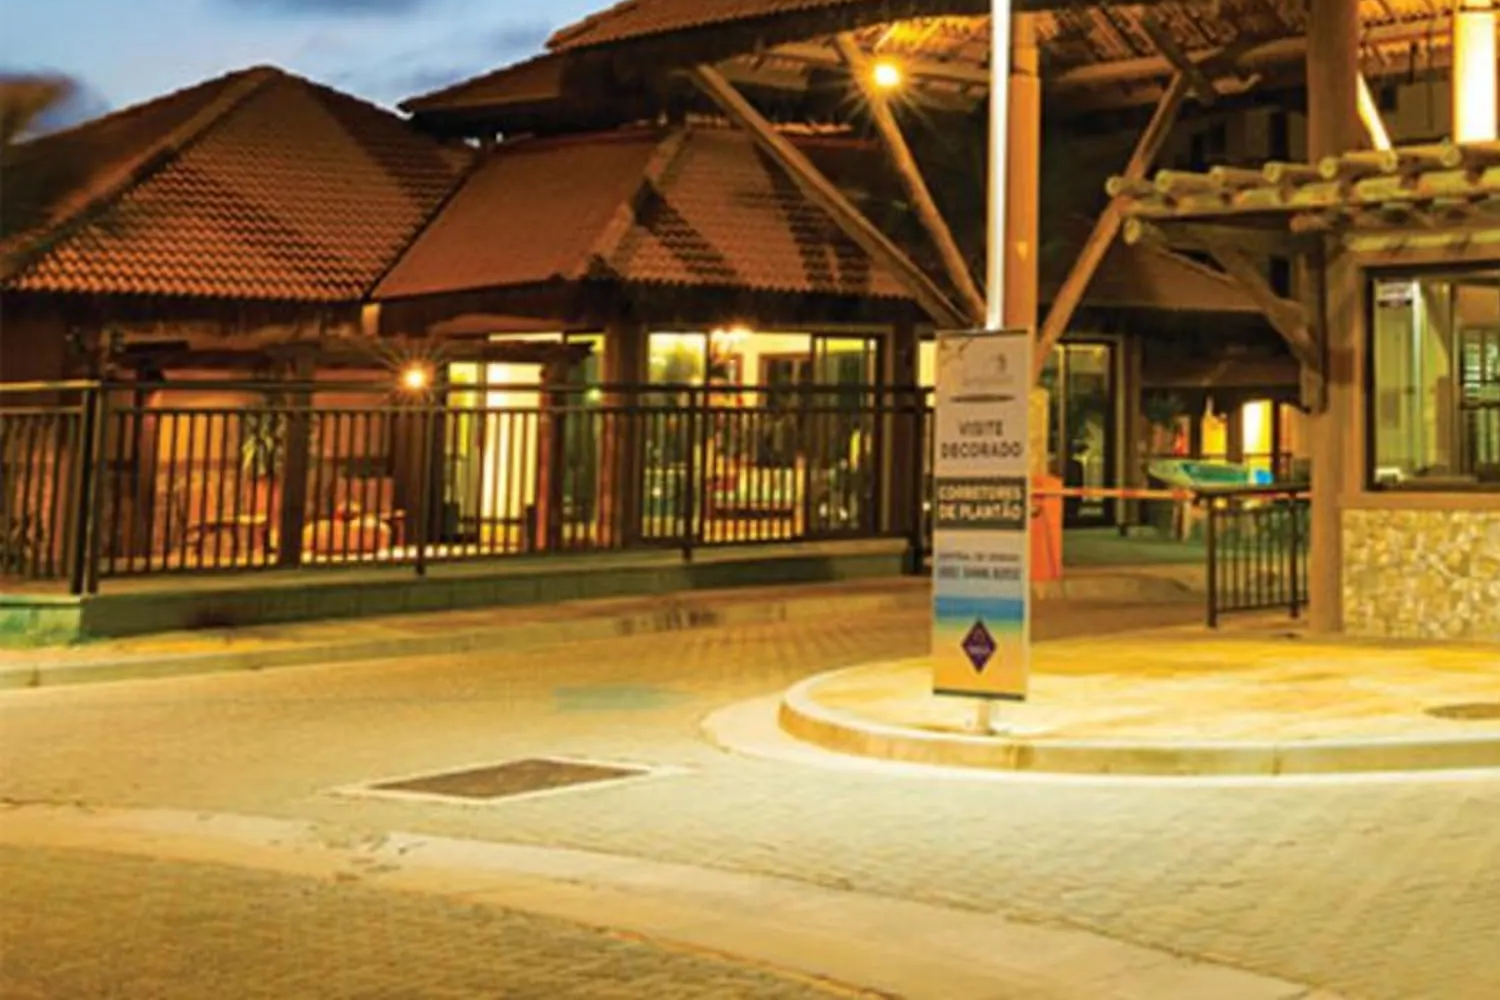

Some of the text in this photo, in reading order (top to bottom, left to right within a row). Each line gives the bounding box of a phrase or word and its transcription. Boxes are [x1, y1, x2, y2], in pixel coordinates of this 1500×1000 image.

[958, 420, 1004, 437] VISITE
[941, 441, 1023, 459] DECORADO
[938, 503, 956, 520] DE
